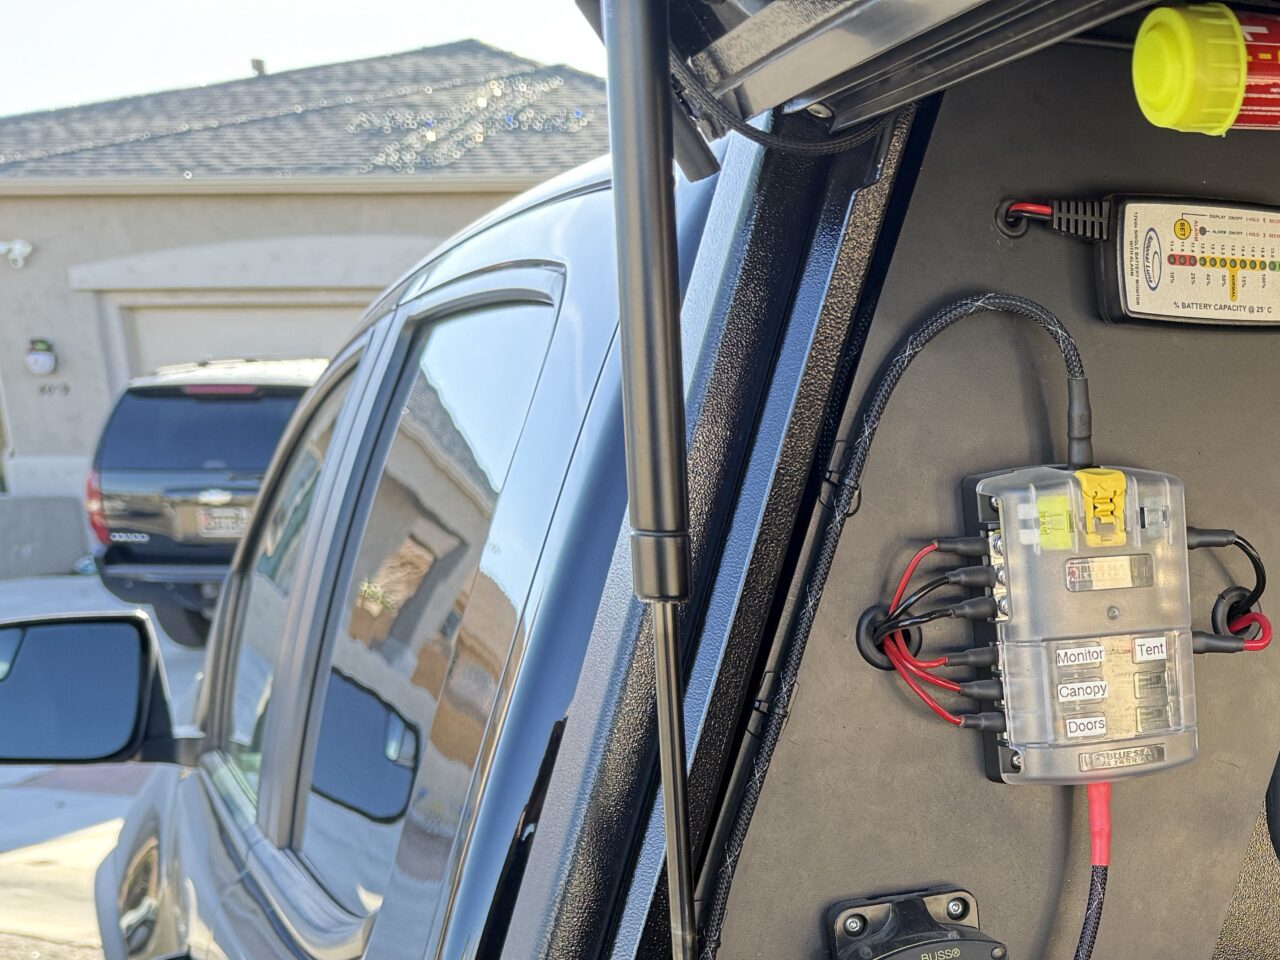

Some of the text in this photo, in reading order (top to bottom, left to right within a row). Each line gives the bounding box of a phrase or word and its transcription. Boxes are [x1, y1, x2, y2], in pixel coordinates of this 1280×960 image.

[1181, 302, 1212, 311] BATTERY
[1213, 303, 1247, 313] CAPACITY
[1057, 648, 1104, 665] Monitor
[1137, 642, 1165, 657] Tent
[1059, 683, 1107, 698] Canopy
[1068, 719, 1105, 734] Doors
